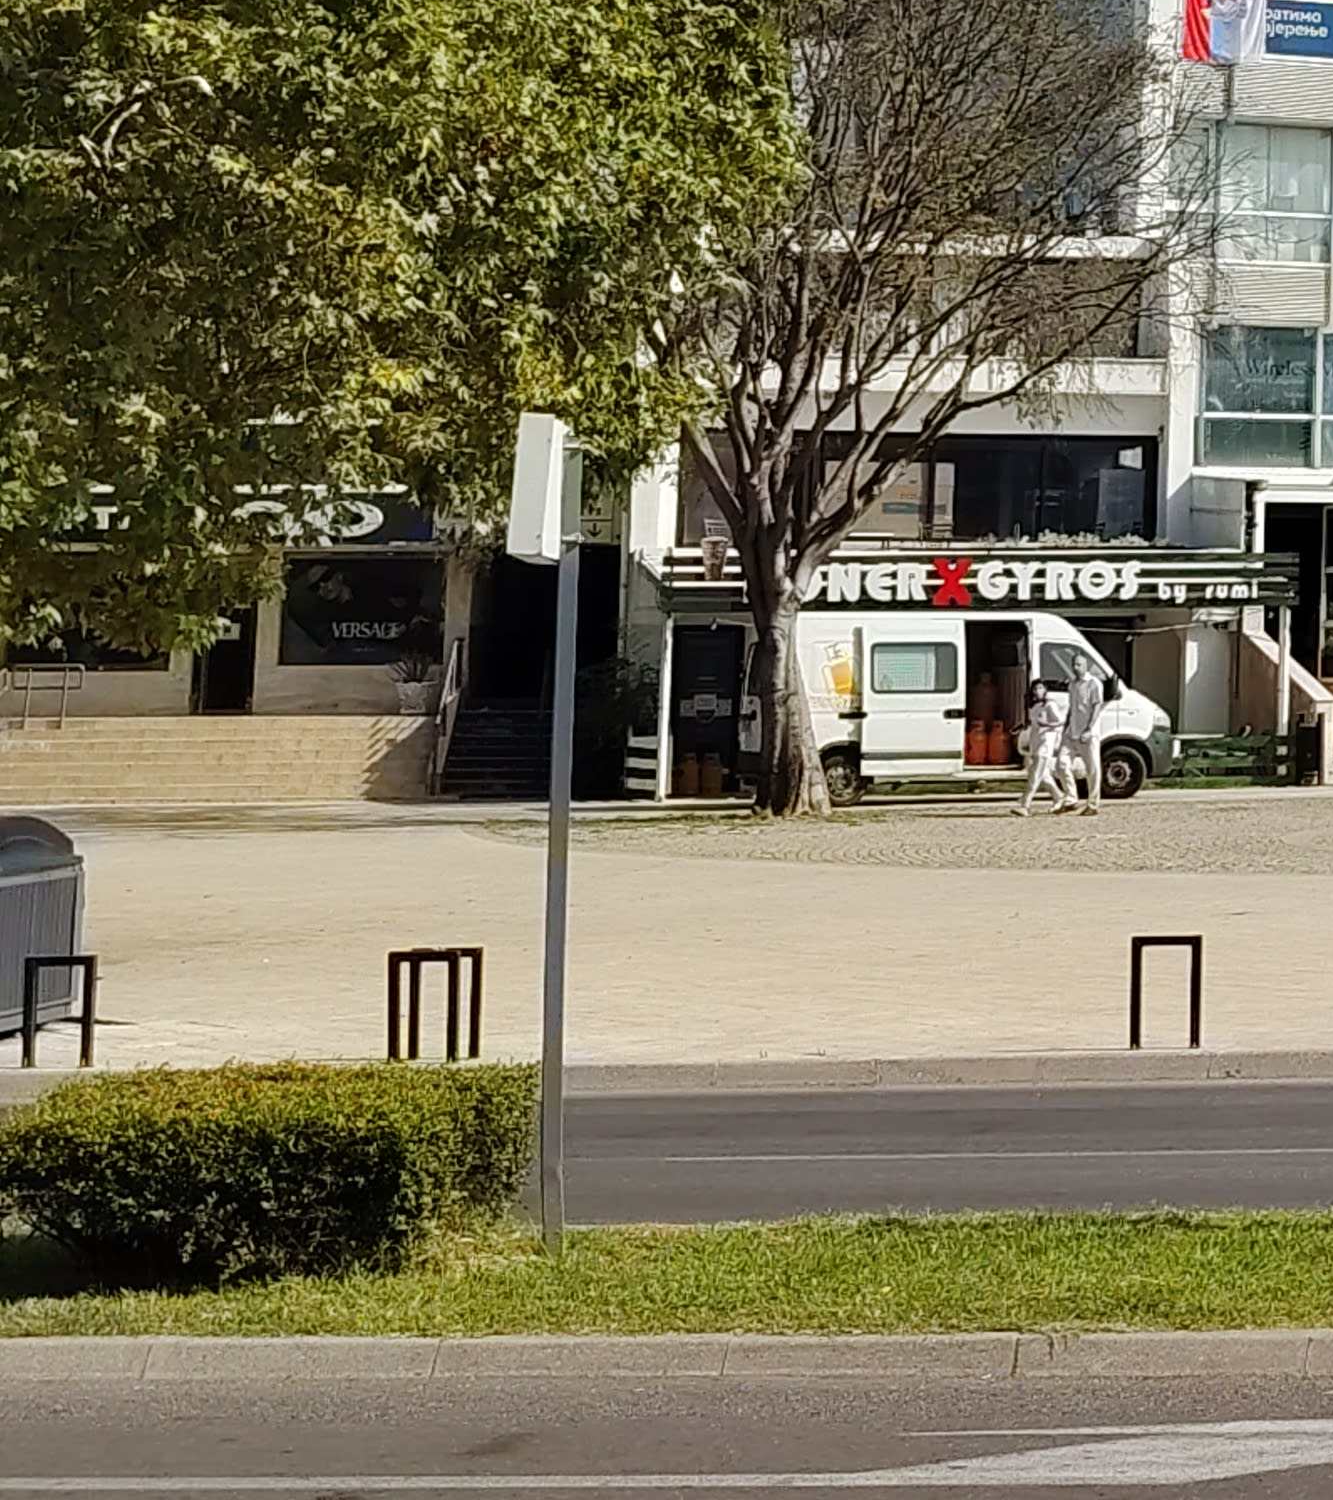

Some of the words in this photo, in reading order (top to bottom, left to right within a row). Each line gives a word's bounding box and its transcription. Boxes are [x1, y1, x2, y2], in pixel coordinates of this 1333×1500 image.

[1265, 9, 1322, 24] ратимо
[803, 560, 928, 602] NER
[978, 560, 1143, 601] GYROS
[1157, 580, 1188, 604] by
[1205, 580, 1259, 599] rumi
[332, 621, 401, 639] VERSACE
